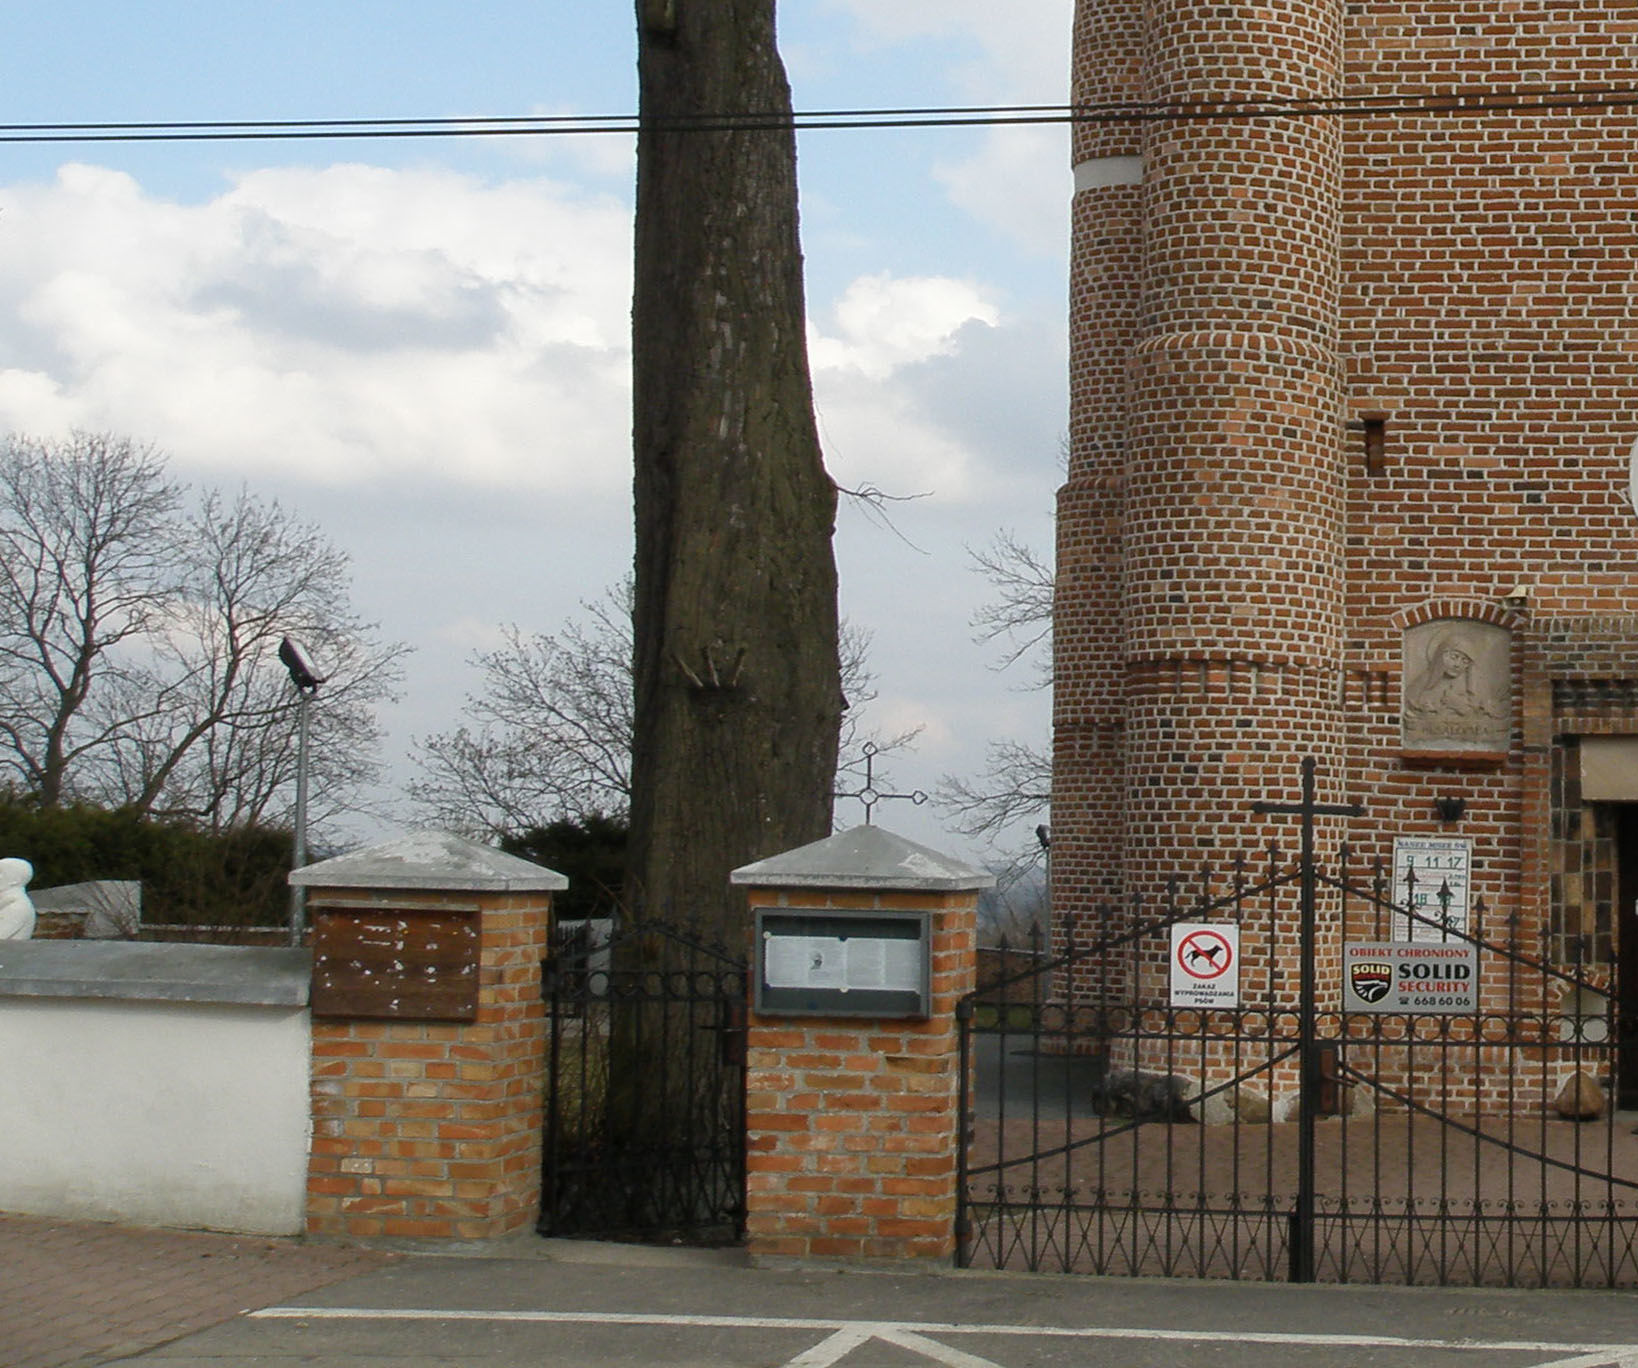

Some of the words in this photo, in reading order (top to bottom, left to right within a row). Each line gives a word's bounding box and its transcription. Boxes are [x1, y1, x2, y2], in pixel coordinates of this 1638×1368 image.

[1349, 947, 1393, 958] OBIEKT
[1397, 948, 1470, 958] CHRONIONY
[1352, 964, 1391, 976] SOLID
[1398, 963, 1471, 980] SOLID
[1397, 980, 1470, 993] SECURITY
[1414, 996, 1437, 1006] 668
[1438, 996, 1453, 1006] 60
[1455, 996, 1471, 1006] 06
